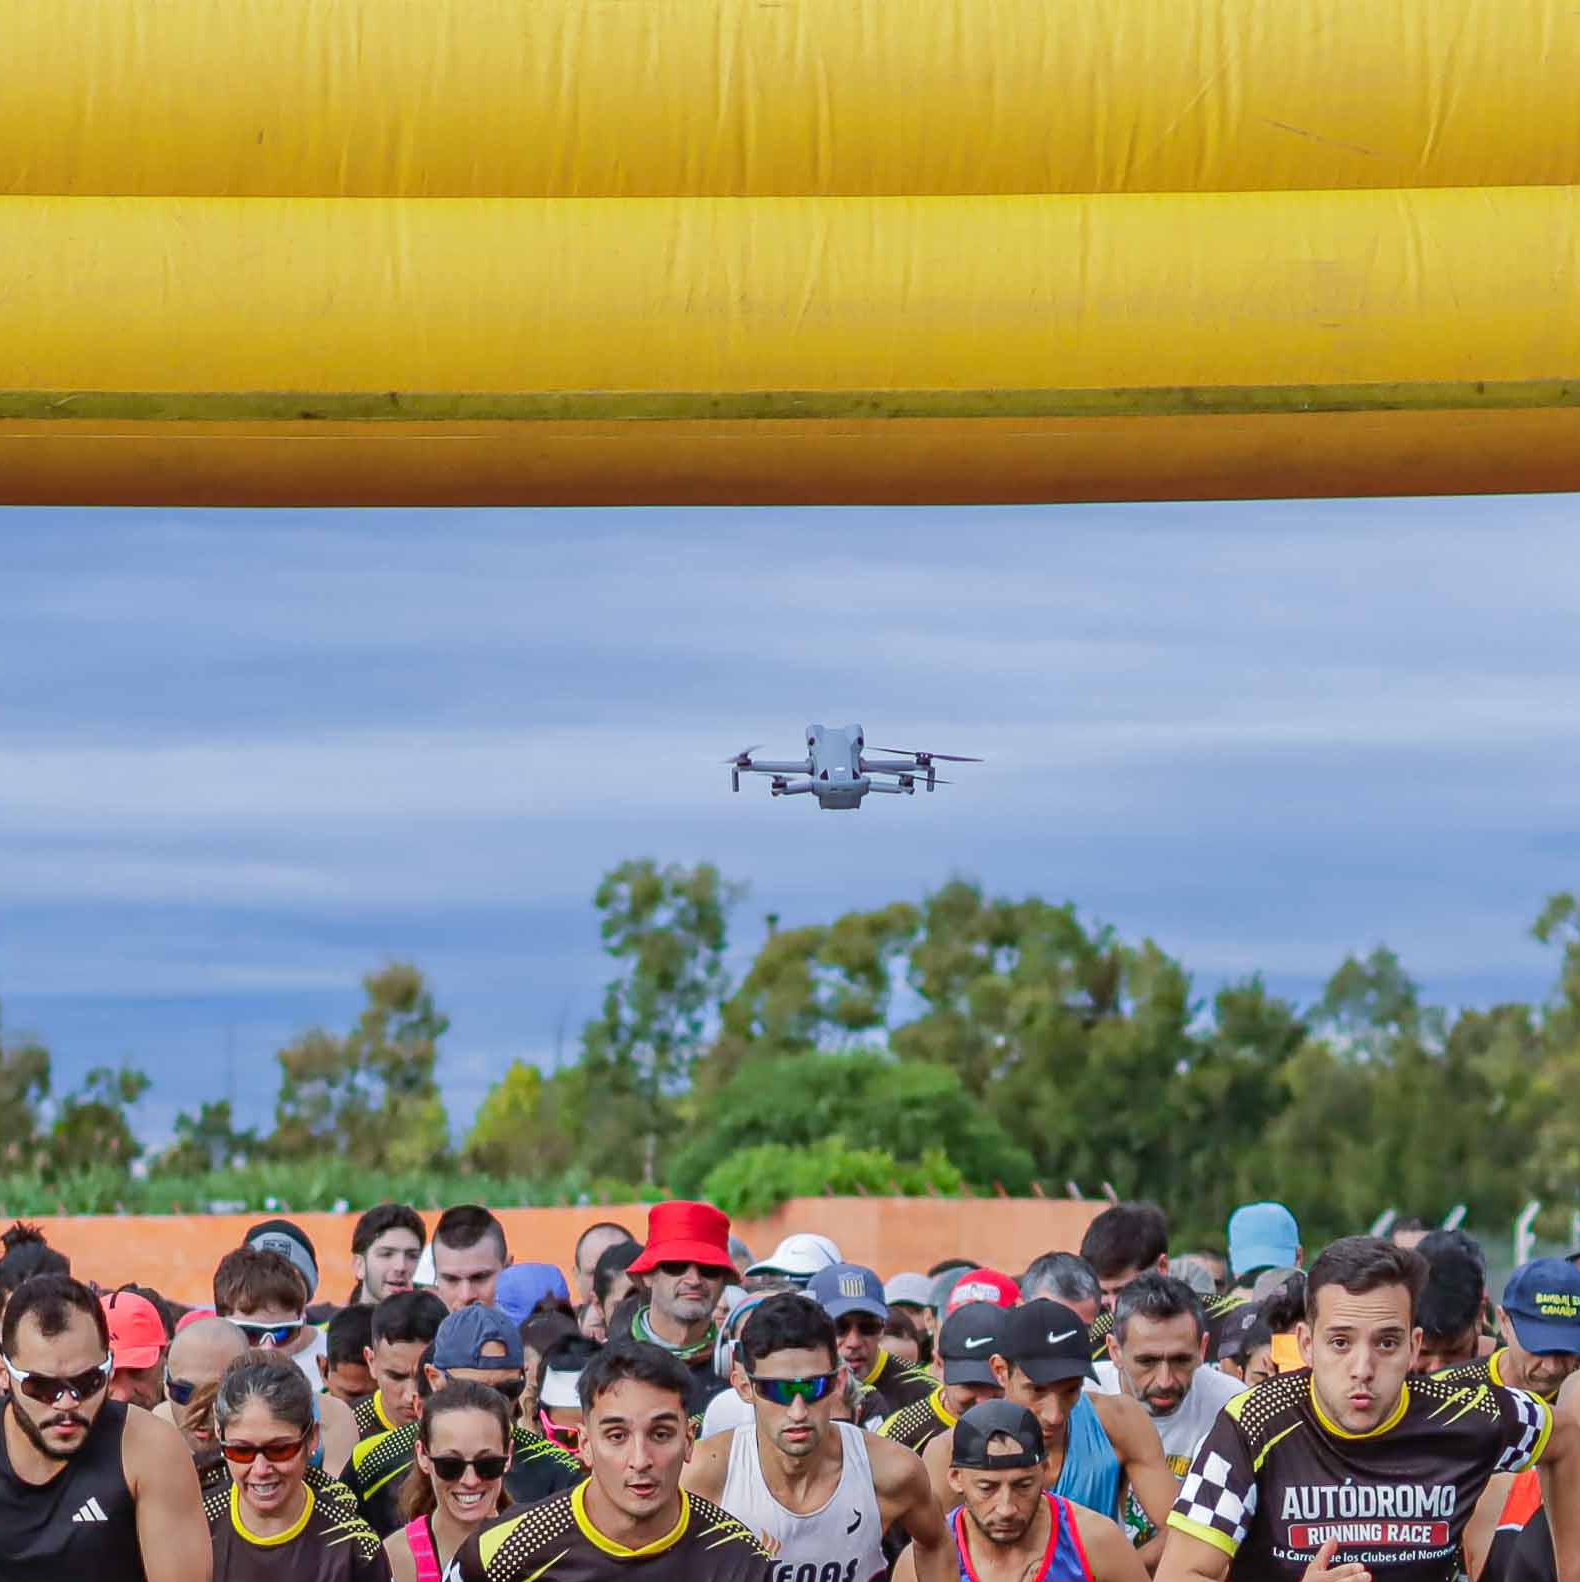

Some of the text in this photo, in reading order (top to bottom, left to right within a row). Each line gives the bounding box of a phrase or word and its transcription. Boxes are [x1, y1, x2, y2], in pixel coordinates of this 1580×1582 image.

[1280, 1478, 1457, 1521] AUTÓDROMO
[1307, 1523, 1433, 1545] RUNNING RACE
[1273, 1546, 1285, 1558] La
[1286, 1550, 1315, 1562] Carre
[1343, 1551, 1359, 1563] los
[1361, 1551, 1397, 1563] Clubes
[1399, 1551, 1416, 1562] del
